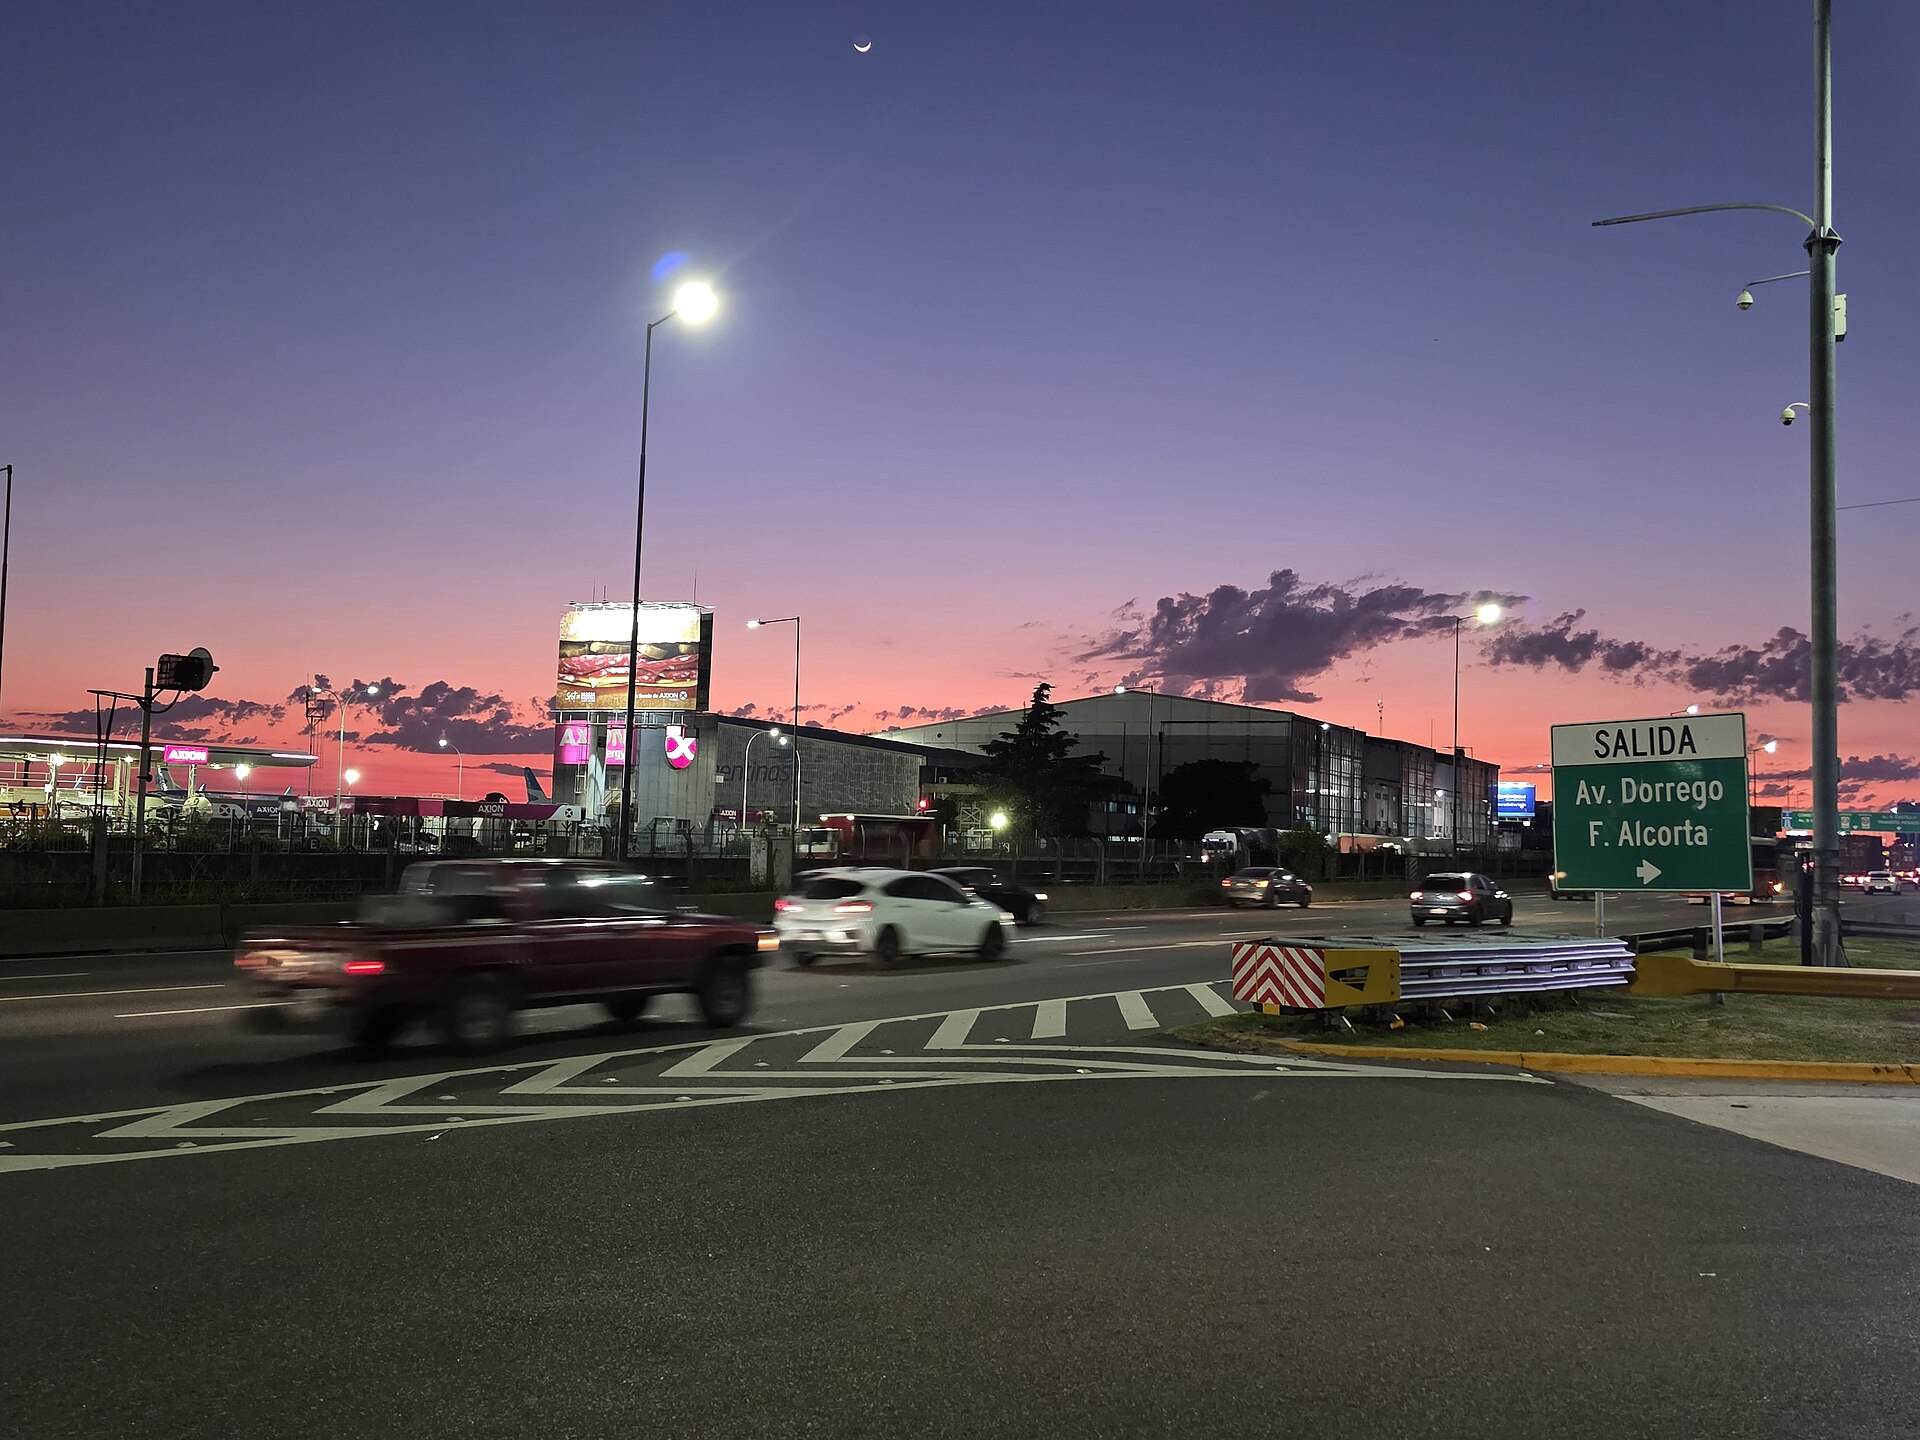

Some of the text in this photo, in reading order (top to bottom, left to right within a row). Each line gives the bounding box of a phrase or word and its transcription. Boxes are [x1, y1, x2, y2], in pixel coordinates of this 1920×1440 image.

[1594, 725, 1697, 759] SALIDA
[168, 750, 206, 761] AXION
[1575, 777, 1724, 810] Av. Dorrego
[306, 799, 329, 808] AXION
[478, 804, 504, 813] AXION
[1589, 819, 1708, 847] F. Alcorta
[310, 839, 317, 850] E
